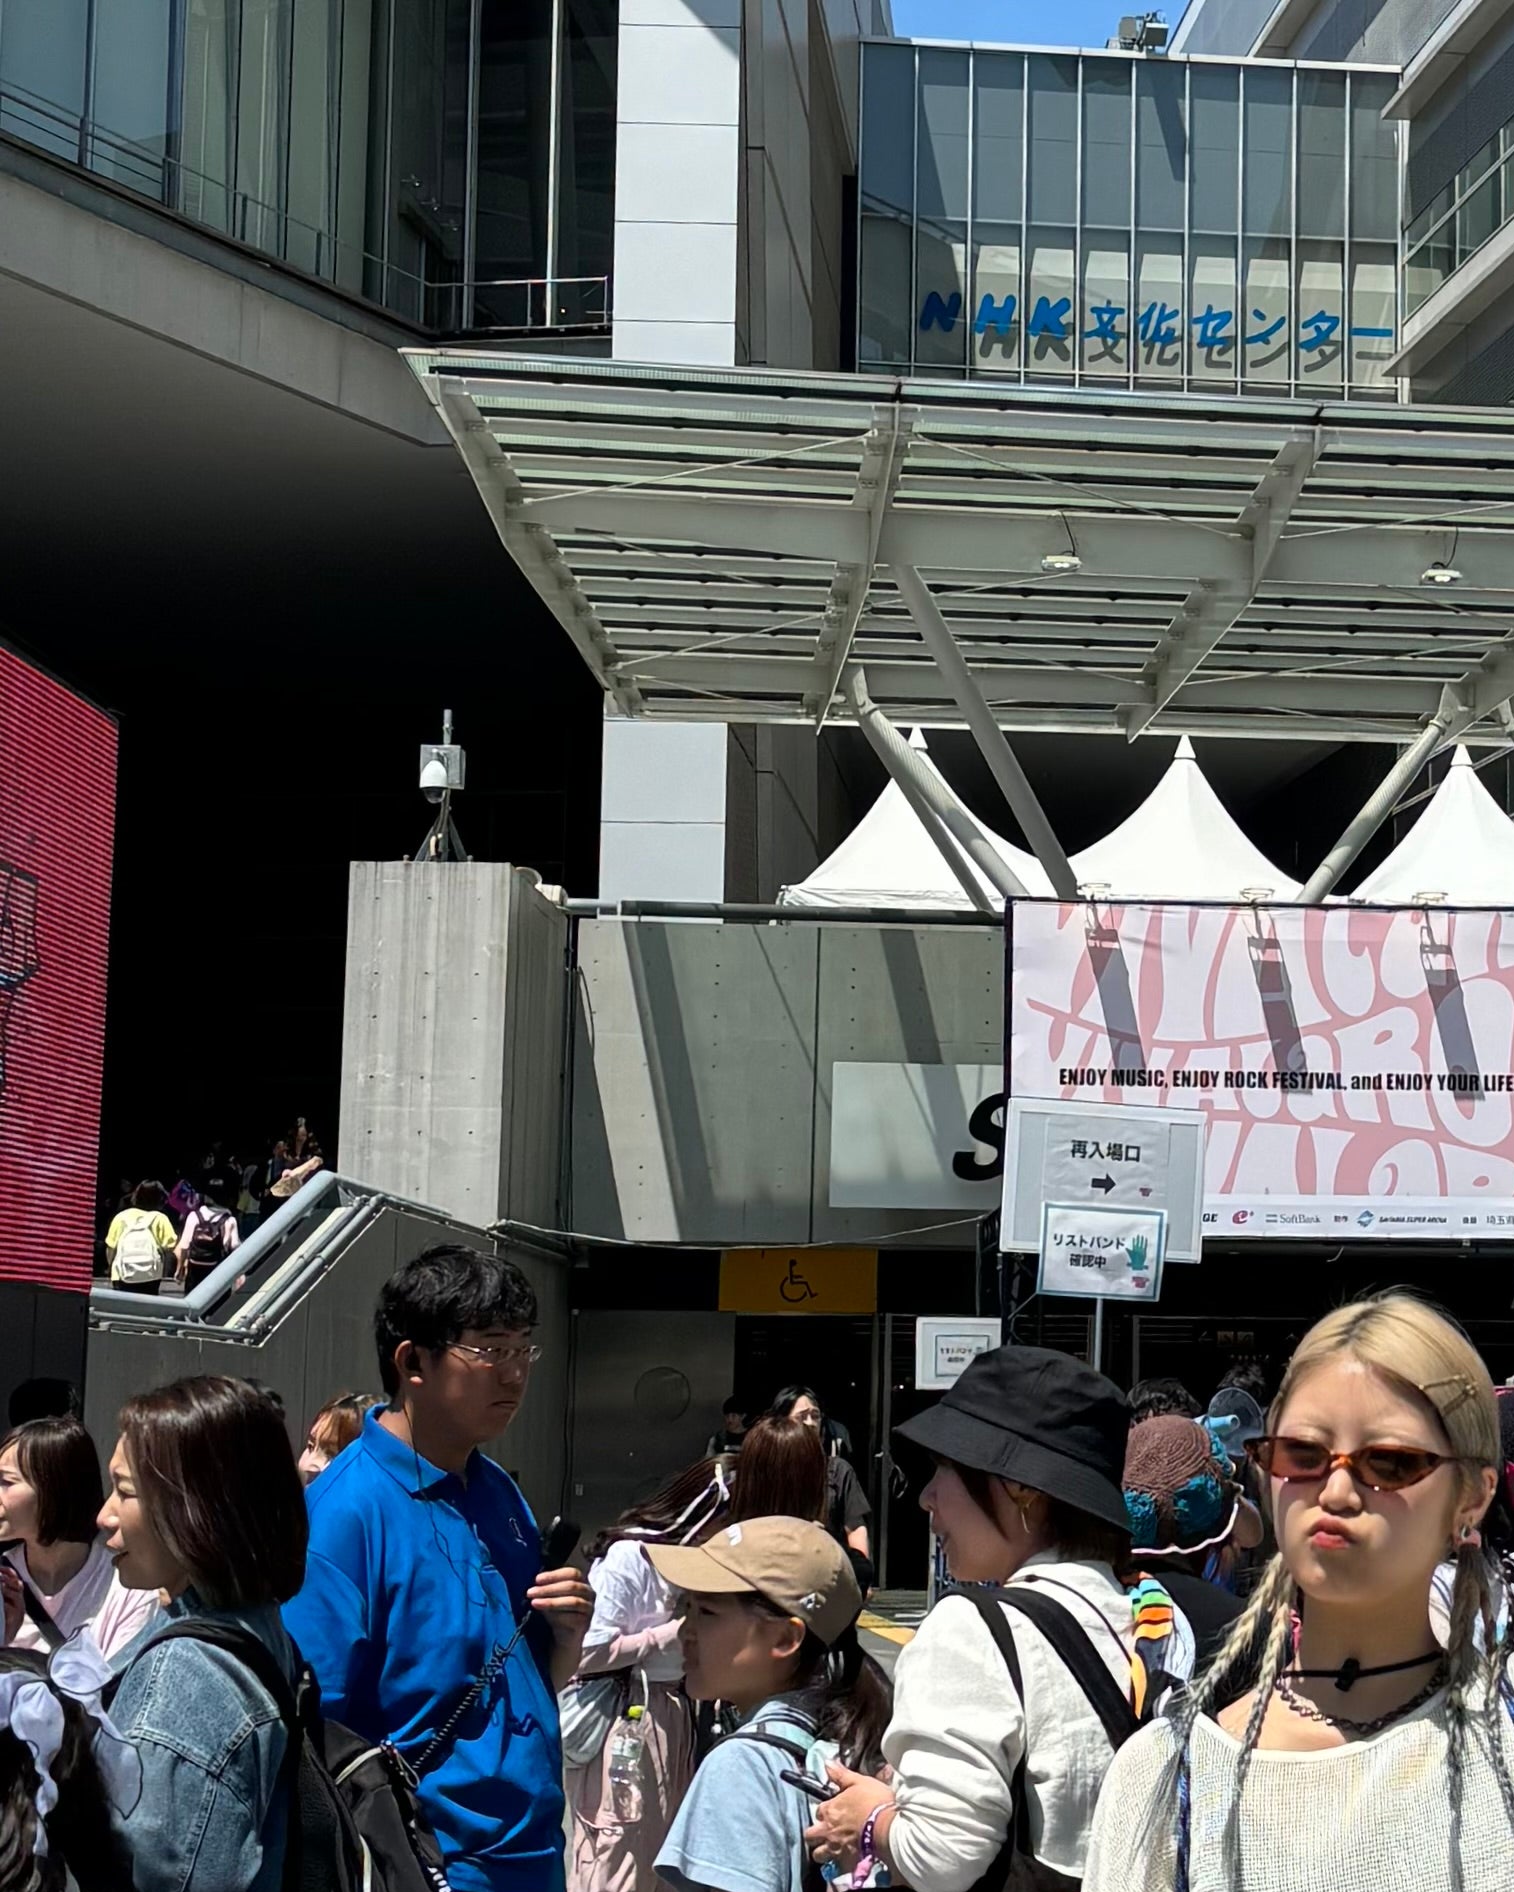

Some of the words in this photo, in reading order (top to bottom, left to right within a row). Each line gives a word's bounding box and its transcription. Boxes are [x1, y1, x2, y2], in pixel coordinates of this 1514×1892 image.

[1060, 1068, 1106, 1086] ENJOY
[1111, 1069, 1167, 1089] MUSIC,
[1173, 1070, 1219, 1088] ENJOY
[1225, 1071, 1267, 1089] ROCK
[1351, 1073, 1382, 1090] and
[1387, 1074, 1433, 1091] ENJOY
[1437, 1074, 1479, 1092] YOUR
[1070, 1139, 1141, 1162] 再入場口
[1280, 1214, 1320, 1224] SoftBank
[1053, 1234, 1126, 1249] リストバンド
[1069, 1254, 1106, 1268] 確認中
